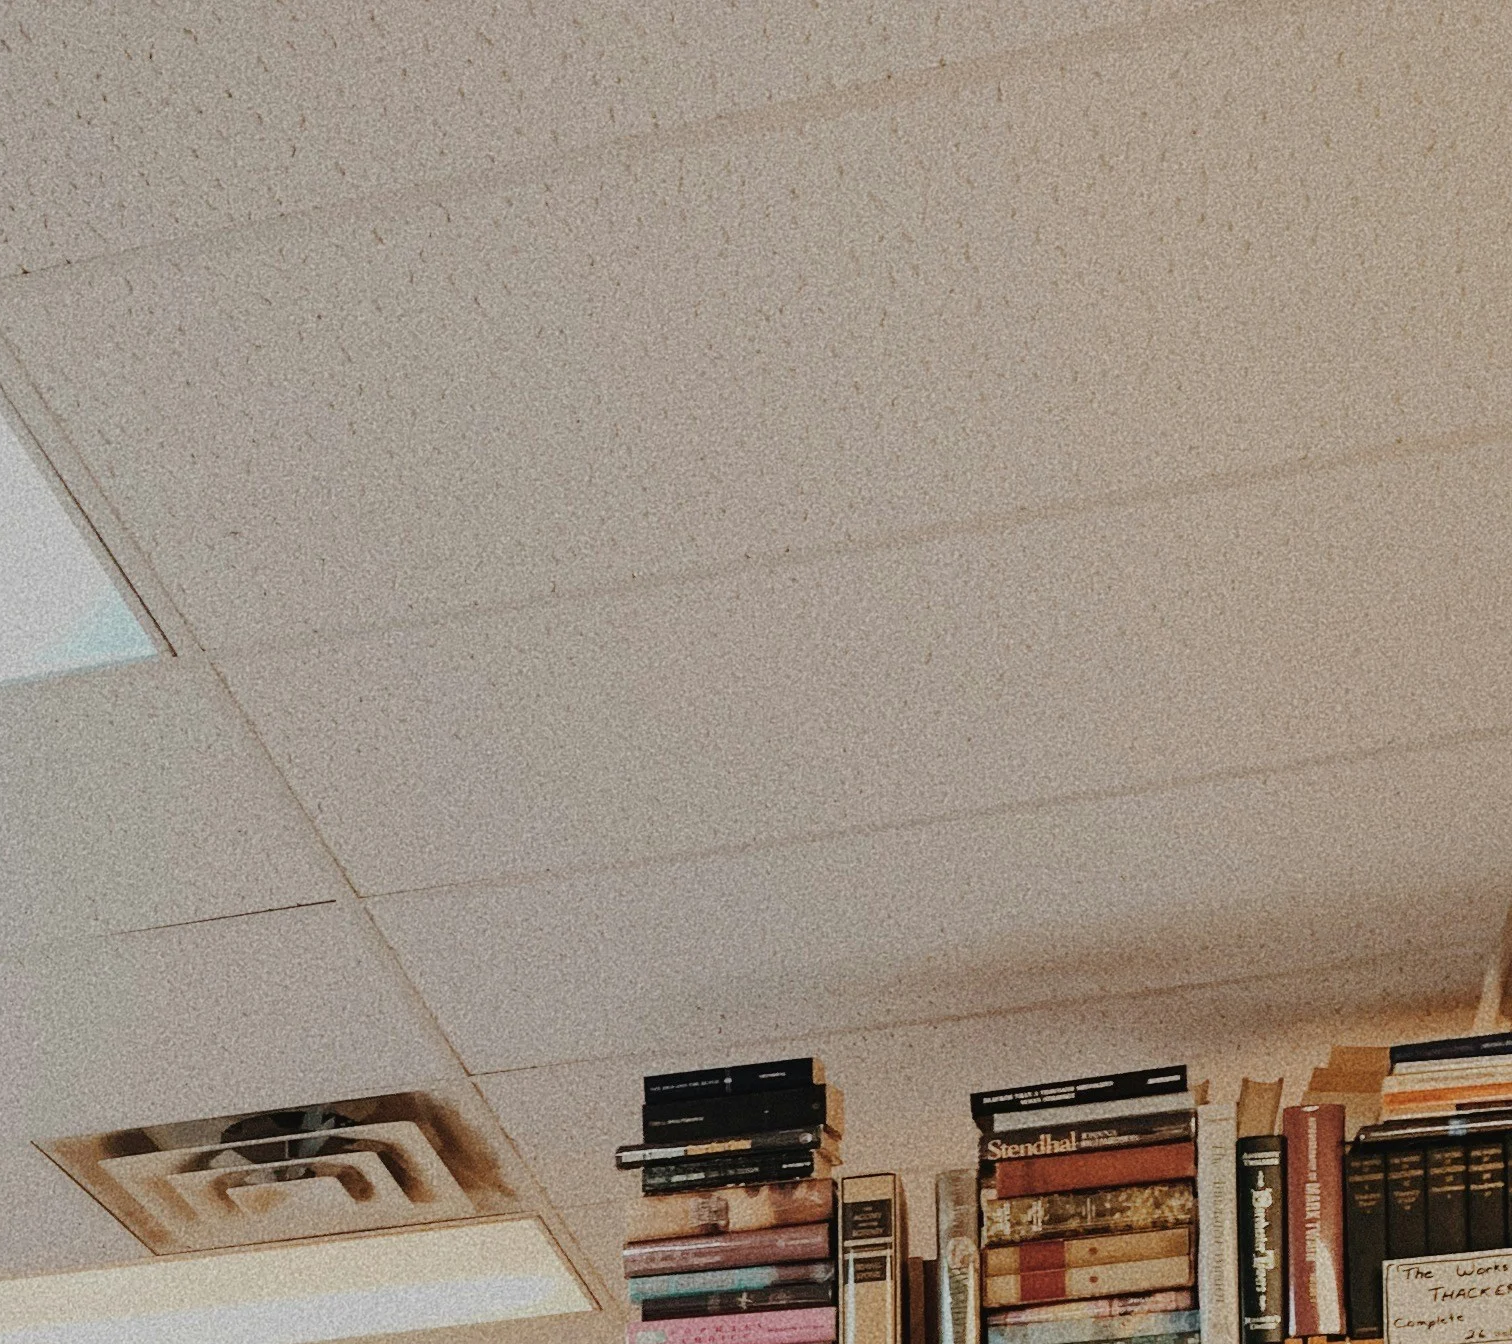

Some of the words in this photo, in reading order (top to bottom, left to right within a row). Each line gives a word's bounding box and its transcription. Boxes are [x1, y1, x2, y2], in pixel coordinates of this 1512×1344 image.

[987, 1131, 1077, 1160] Stendhal
[1305, 1182, 1320, 1219] MARK
[1305, 1222, 1320, 1262] TWAIN
[1402, 1267, 1434, 1280] The
[1456, 1264, 1508, 1278] Works
[1392, 1313, 1466, 1330] Complete
[1464, 1330, 1486, 1340] 26
